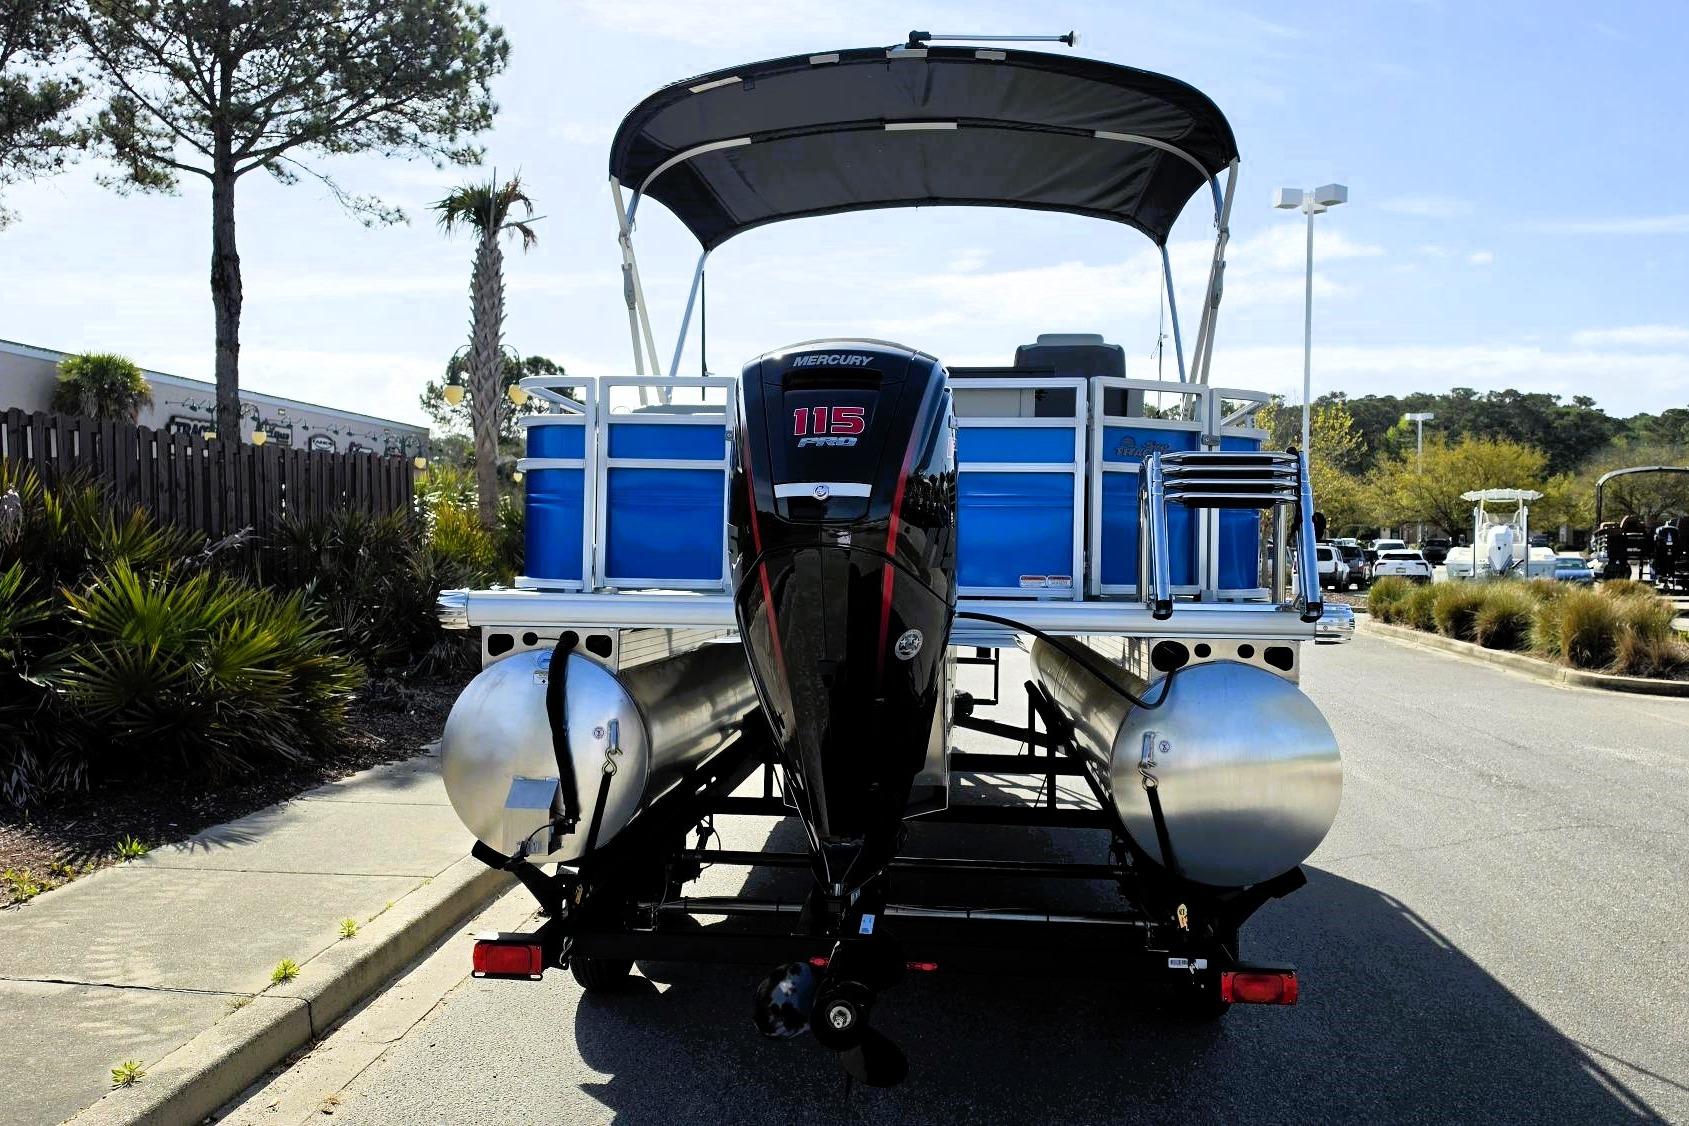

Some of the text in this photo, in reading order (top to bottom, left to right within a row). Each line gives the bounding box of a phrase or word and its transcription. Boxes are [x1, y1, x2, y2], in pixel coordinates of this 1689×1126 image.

[793, 354, 874, 367] MERCURY
[793, 406, 866, 436] 115
[797, 436, 859, 448] PRO
